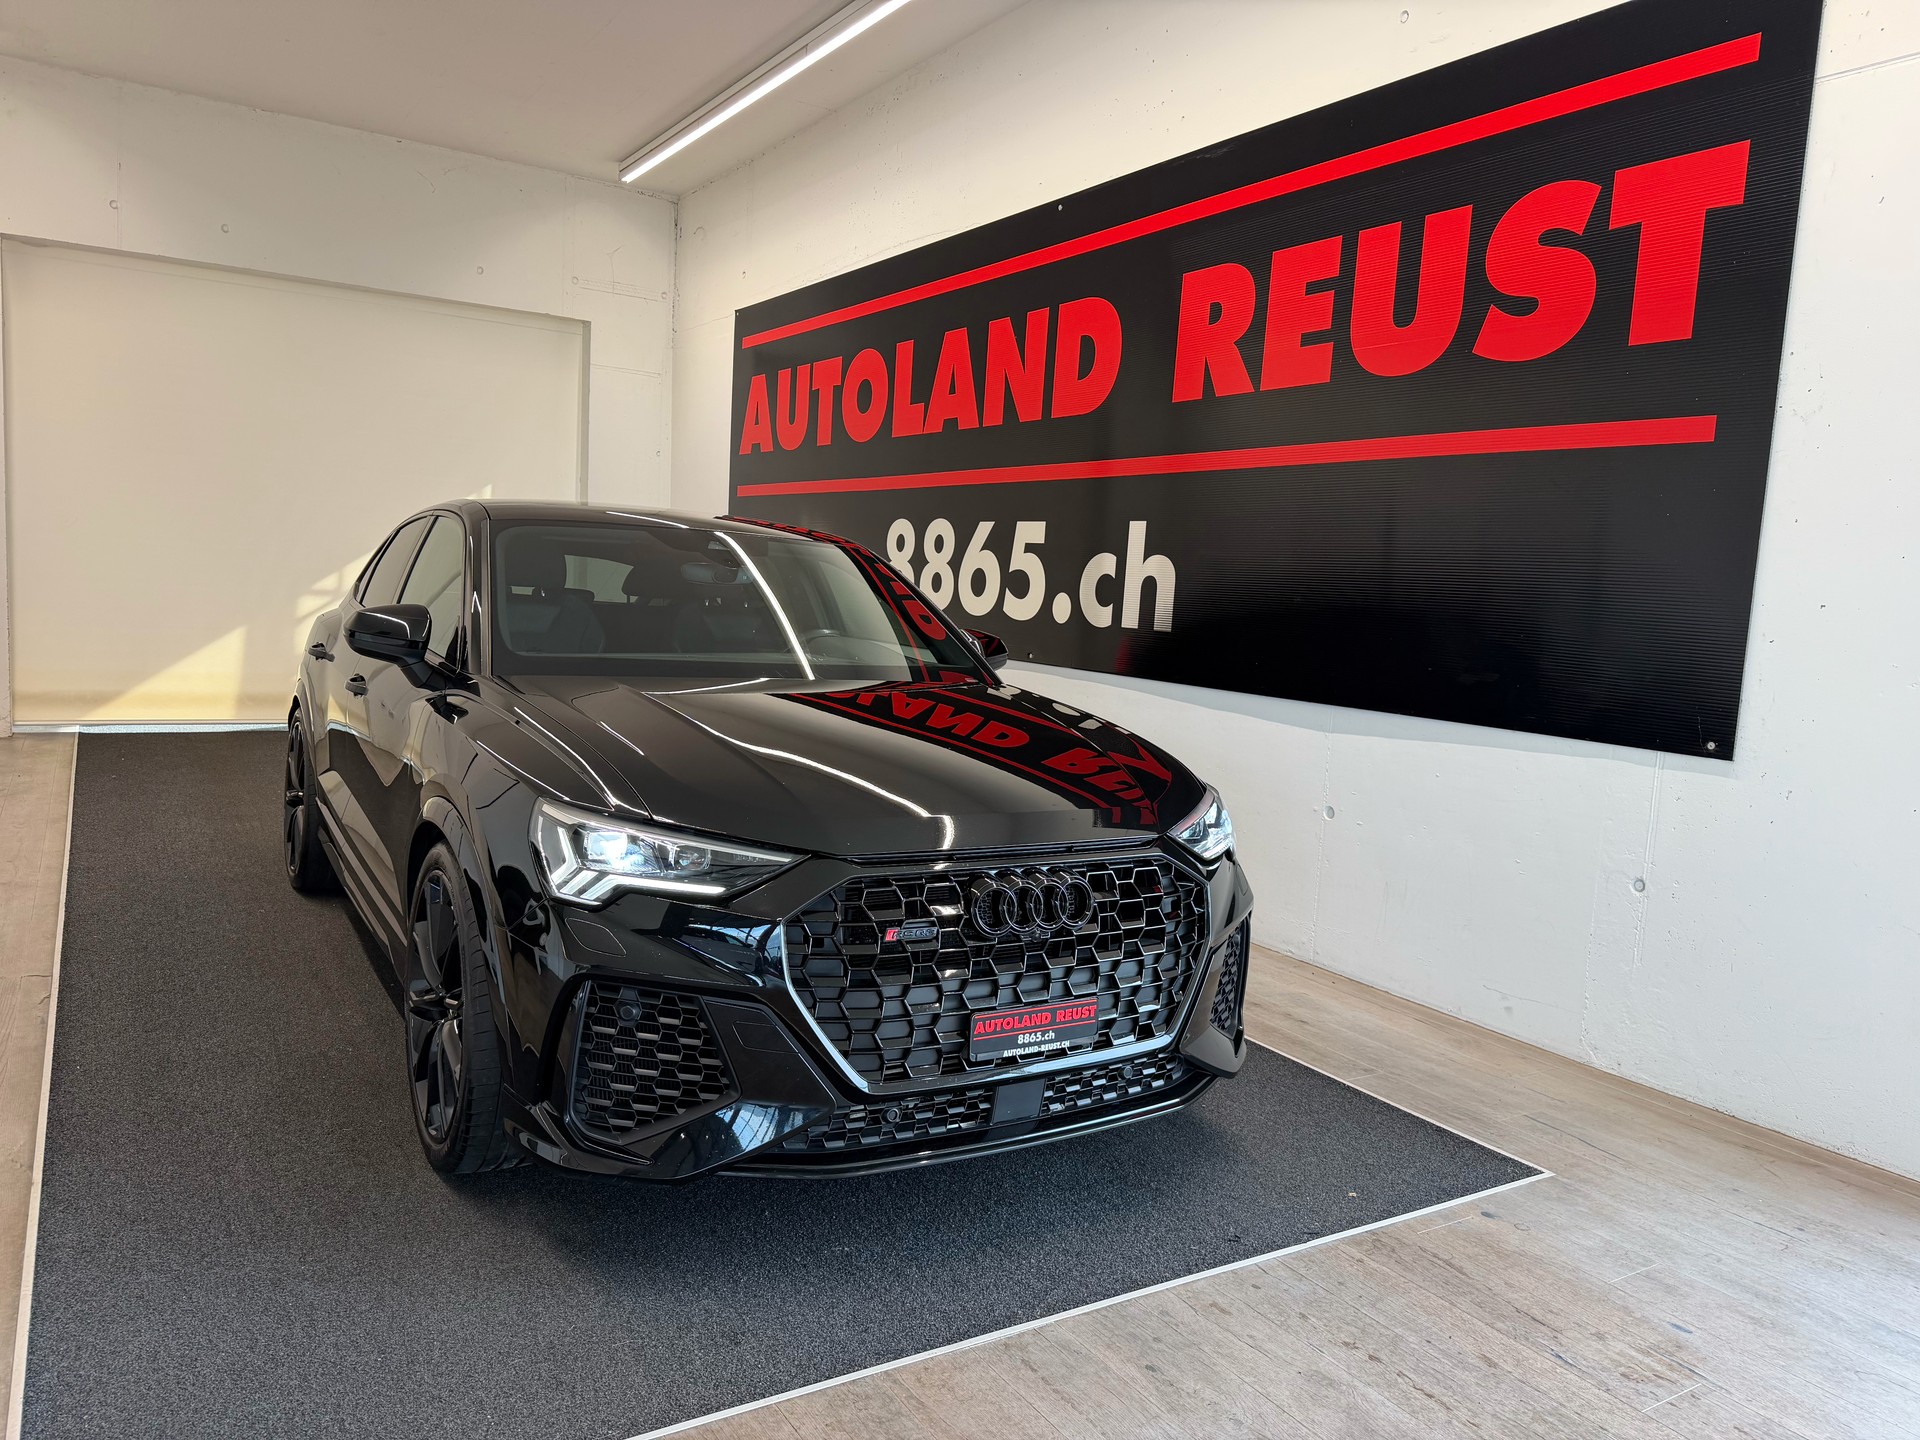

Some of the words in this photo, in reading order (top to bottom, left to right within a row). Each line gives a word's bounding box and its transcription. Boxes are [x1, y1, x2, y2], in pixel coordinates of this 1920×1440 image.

[739, 297, 1122, 455] AUTOLAND
[1171, 139, 1751, 403] REUST
[886, 517, 1177, 632] 8865.ch
[974, 1012, 1052, 1034] AUTOLAND
[1056, 1005, 1097, 1022] REUST
[1003, 1040, 1070, 1057] AUTOLAND-REUST.CH
[1017, 1030, 1055, 1044] 8865.ch
